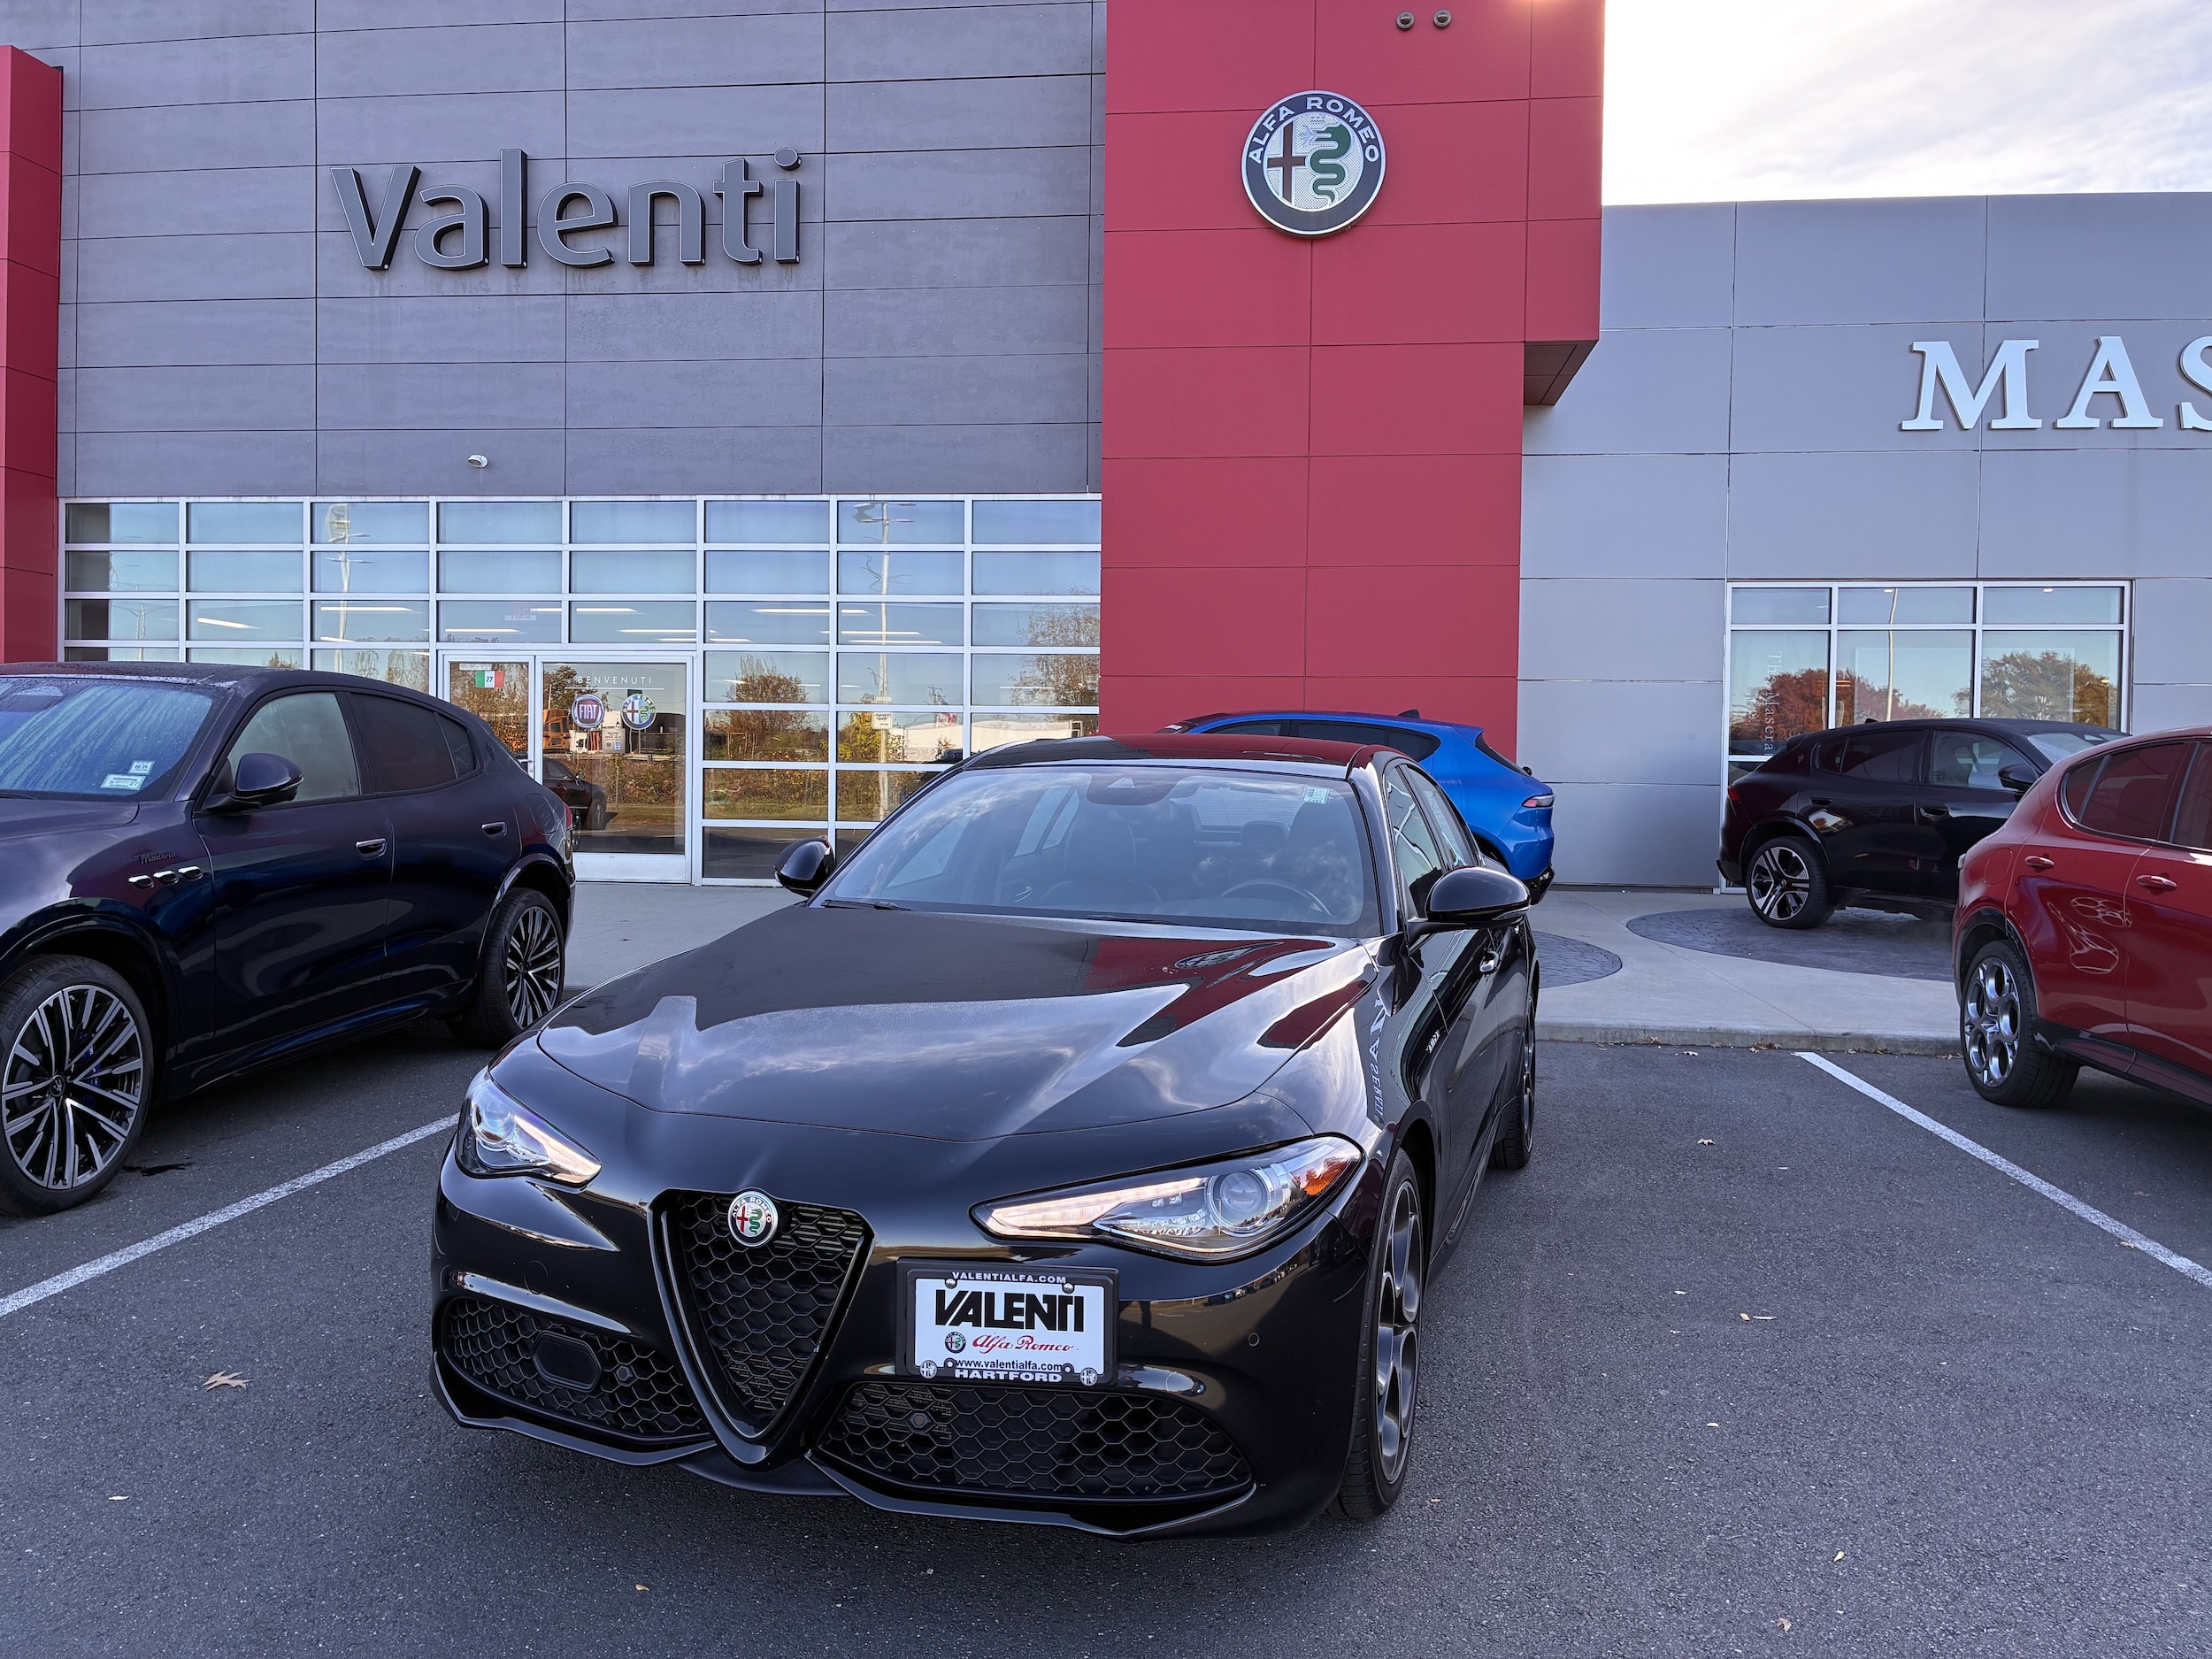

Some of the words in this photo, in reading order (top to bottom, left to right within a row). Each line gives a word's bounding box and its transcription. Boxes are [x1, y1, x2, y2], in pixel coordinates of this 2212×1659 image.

[1248, 105, 1294, 165] ALFA
[1306, 96, 1379, 163] ROMEO
[330, 147, 801, 270] Valenti
[578, 676, 652, 685] BENVENUTI
[579, 703, 598, 719] FIAT
[623, 696, 635, 713] ALFA
[637, 695, 656, 714] ROMEO
[732, 1198, 747, 1218] ALFA
[749, 1196, 772, 1224] ROMEO
[951, 1271, 1067, 1284] VALENTIALFA.COM
[935, 1289, 1085, 1333] VALENTI
[972, 1334, 1014, 1355] Alfa
[1014, 1334, 1074, 1352] Romeo
[956, 1359, 1063, 1371] www.valentialfa.com
[954, 1369, 1063, 1383] HARTFORD
